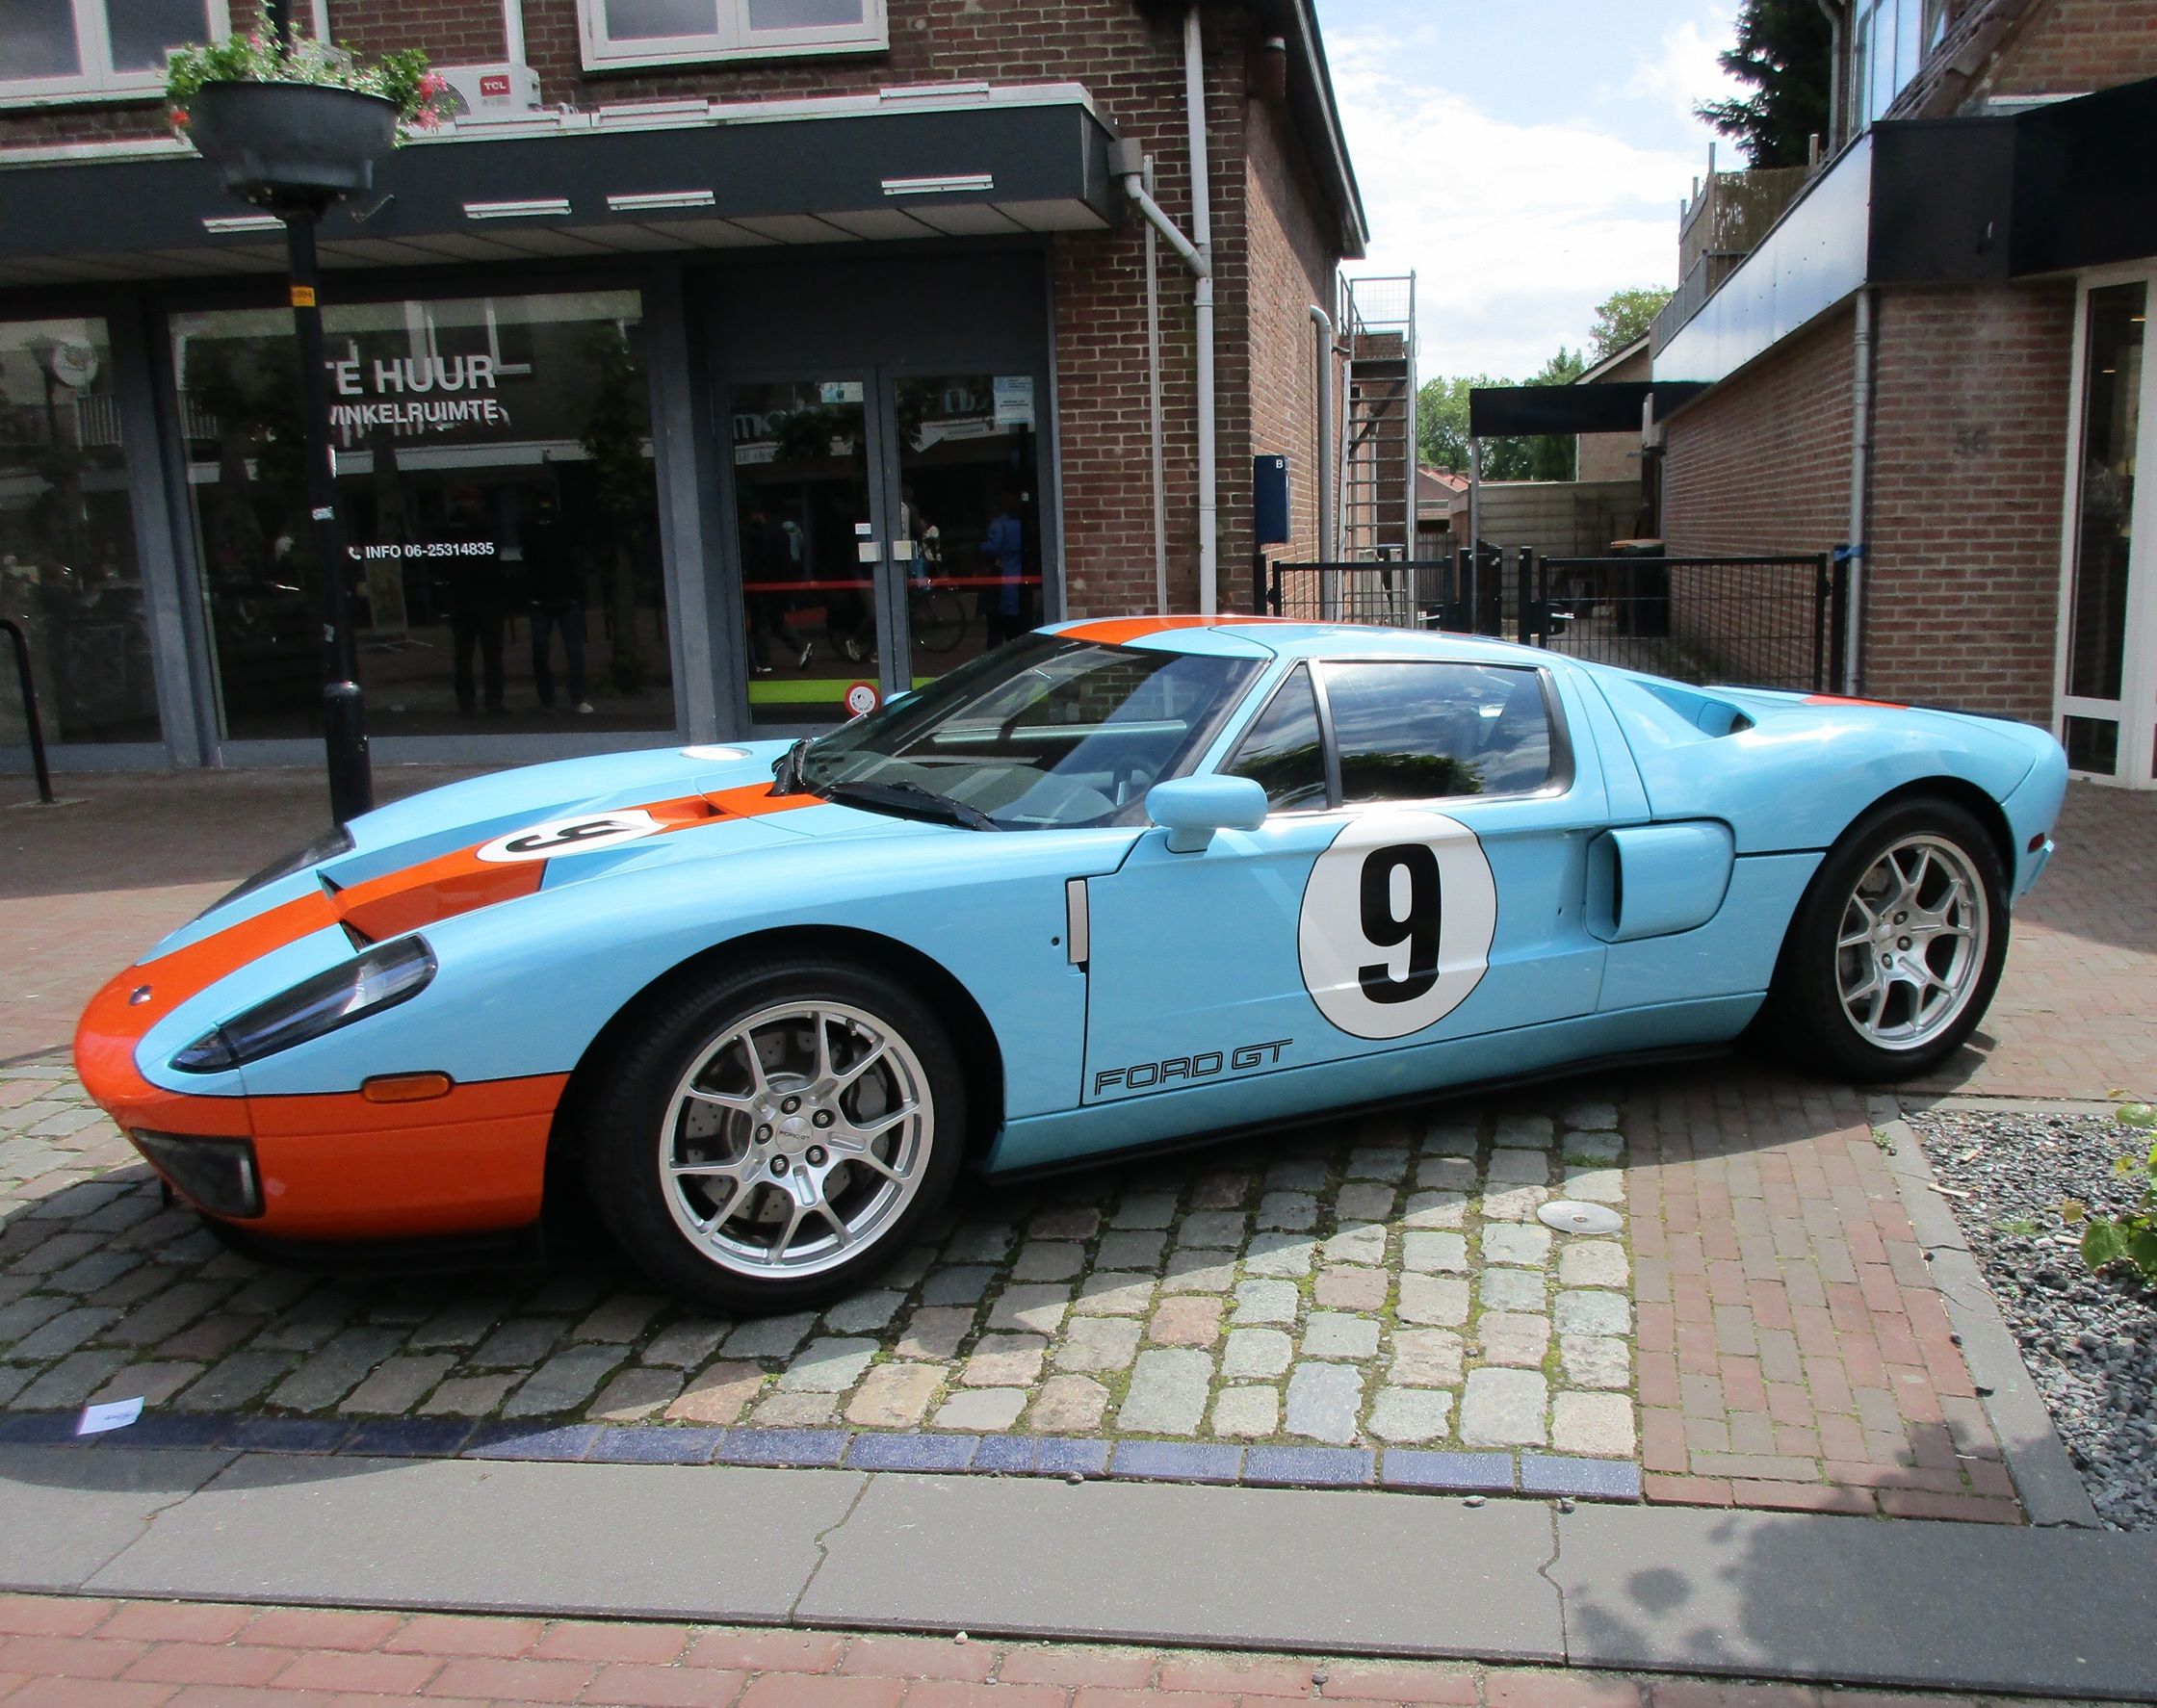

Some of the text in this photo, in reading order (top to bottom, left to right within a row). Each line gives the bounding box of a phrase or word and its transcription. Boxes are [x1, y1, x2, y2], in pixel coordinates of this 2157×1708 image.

[483, 81, 507, 91] TCL
[373, 354, 497, 394] HUUR
[1276, 459, 1284, 469] B
[365, 542, 495, 559] INFO 06-25314835
[1358, 842, 1442, 1005] 9
[1094, 1038, 1293, 1096] FORD GT
